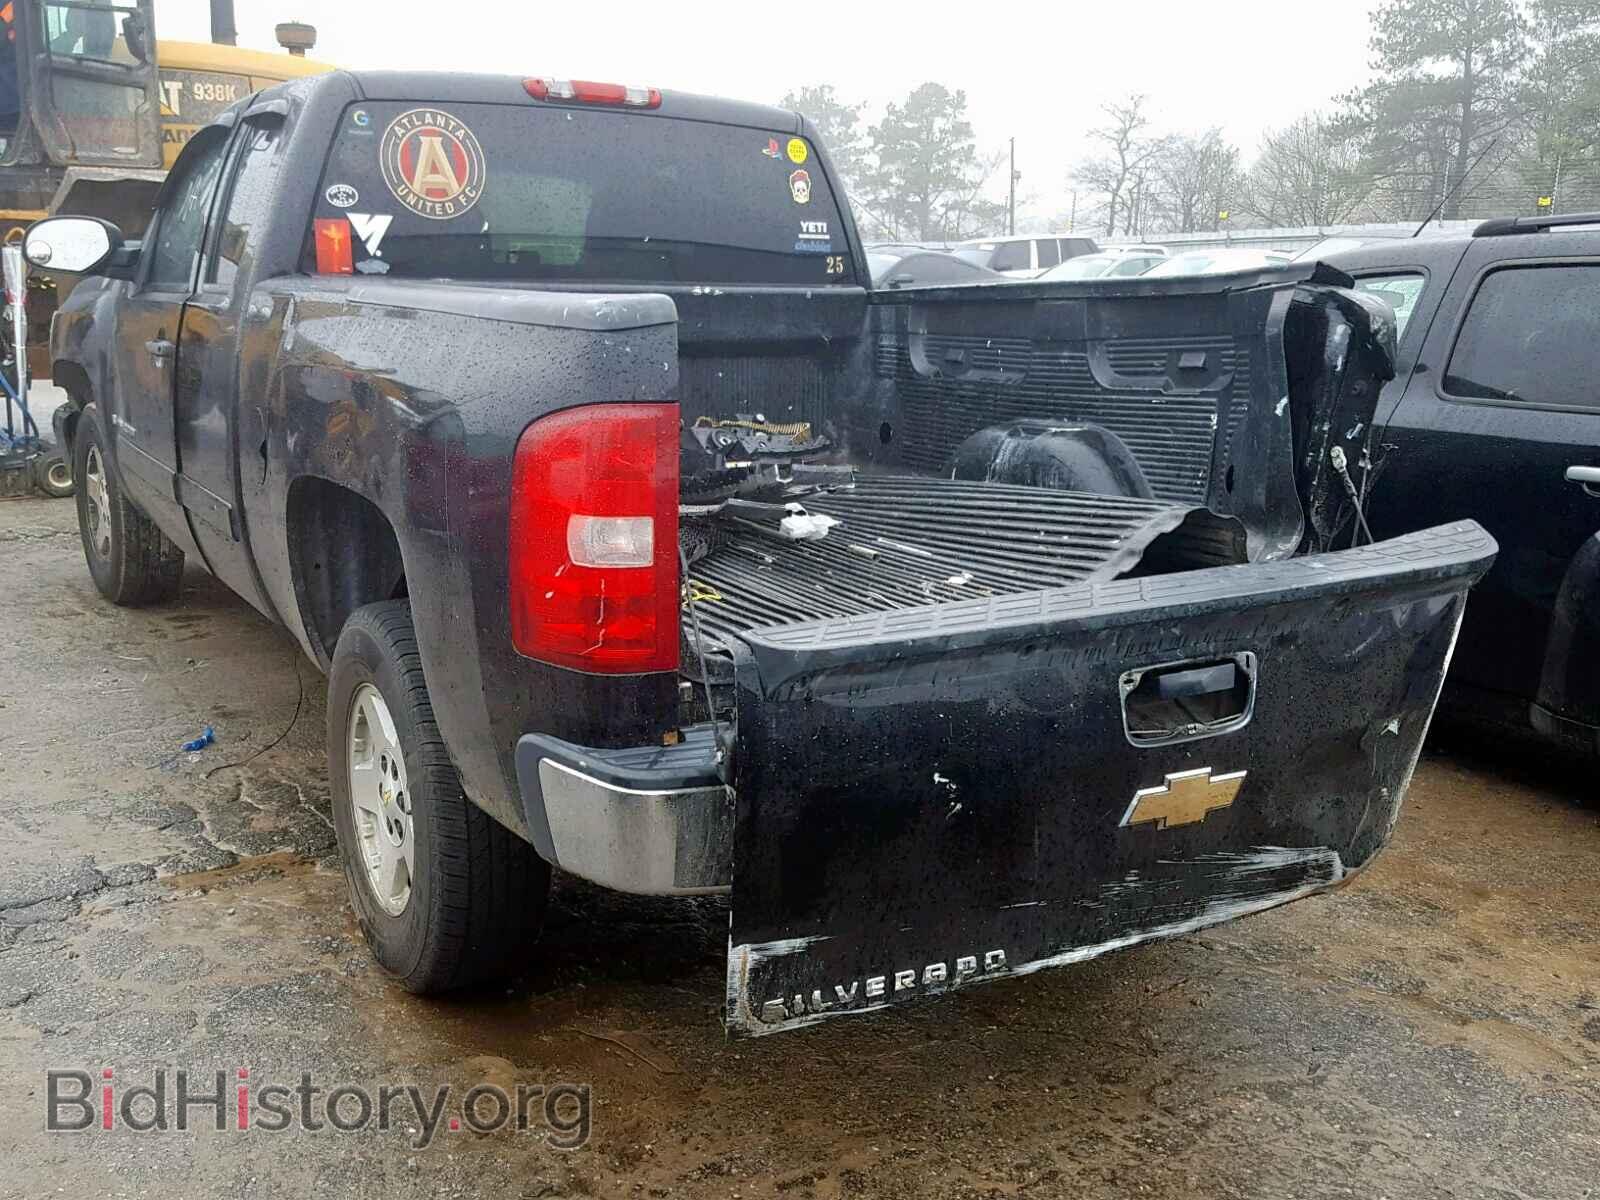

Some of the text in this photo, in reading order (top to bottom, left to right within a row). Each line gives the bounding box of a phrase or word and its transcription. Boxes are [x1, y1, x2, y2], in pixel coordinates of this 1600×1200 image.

[193, 82, 236, 101] 938K
[394, 113, 466, 140] ATLANTA
[396, 184, 476, 215] UNITED FC
[799, 220, 827, 233] YETI
[826, 256, 844, 273] 25
